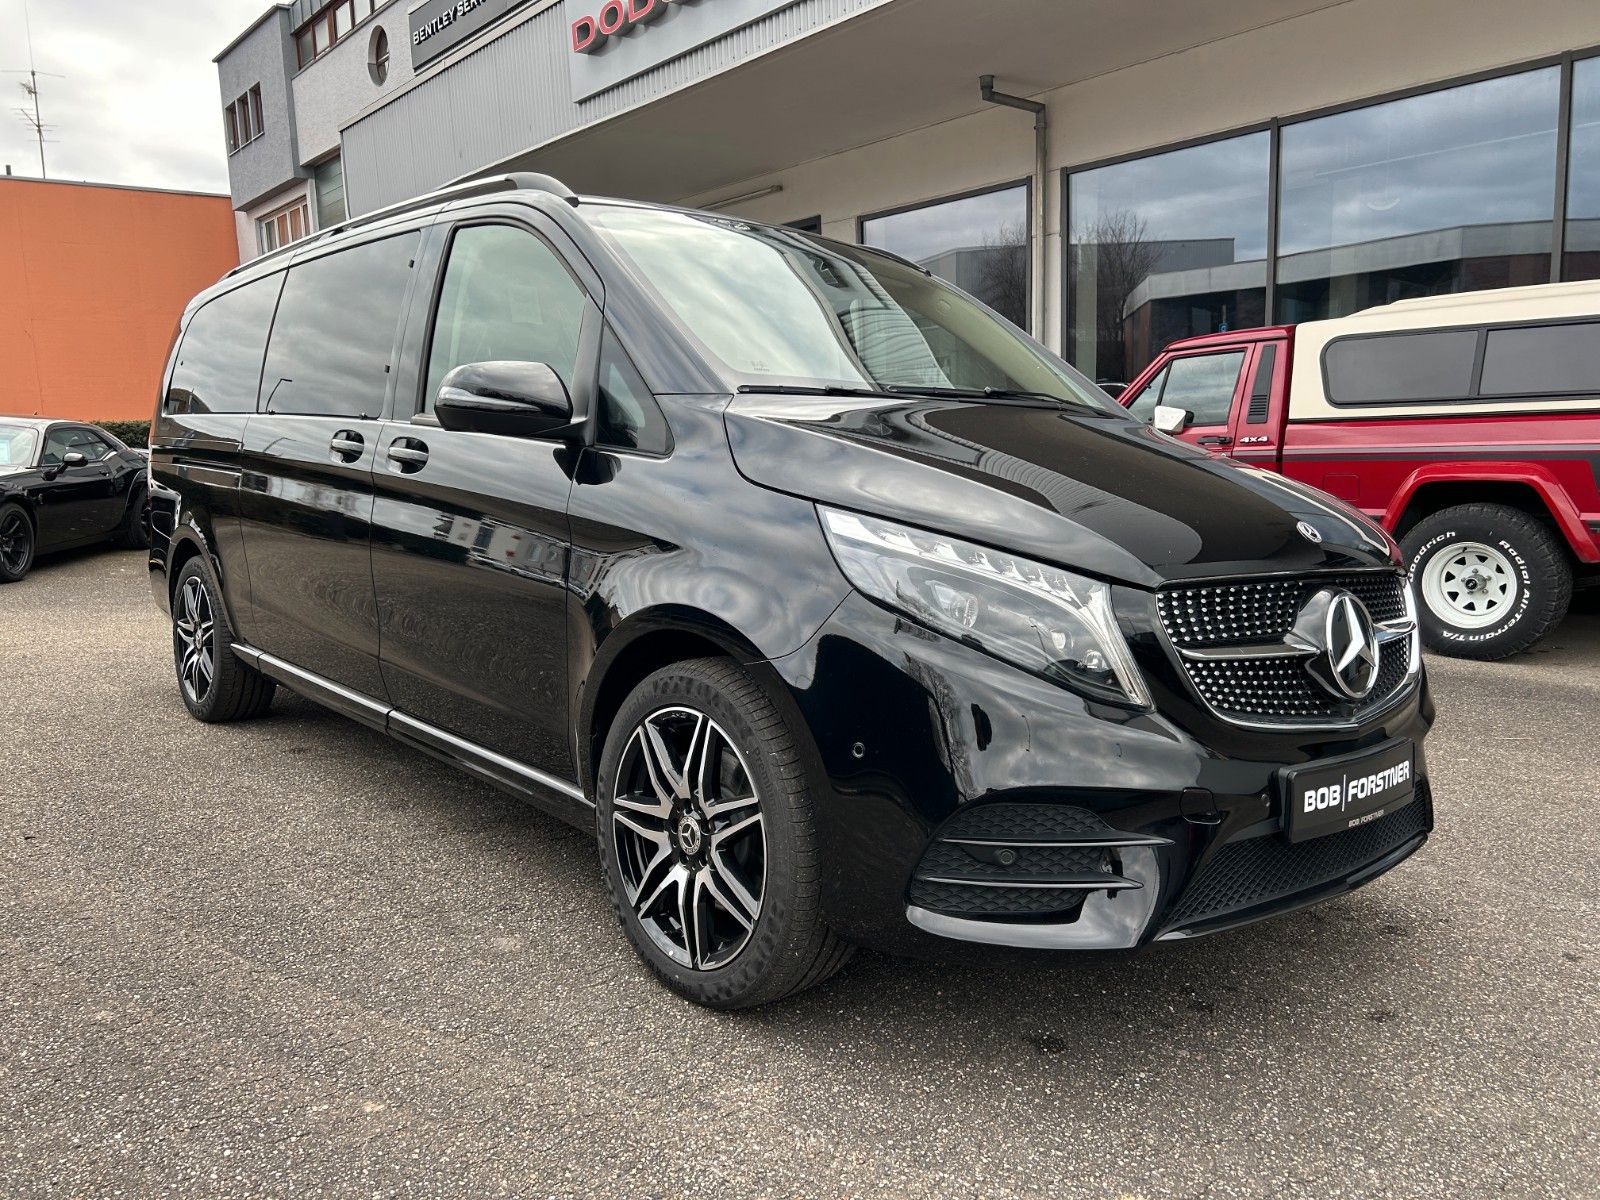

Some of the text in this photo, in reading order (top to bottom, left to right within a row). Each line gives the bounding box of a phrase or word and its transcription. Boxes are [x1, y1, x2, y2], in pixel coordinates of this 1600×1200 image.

[412, 0, 481, 45] BENTLEY SER
[571, 0, 673, 53] DOD
[1498, 540, 1531, 585] Radial
[1442, 630, 1466, 641] T/A
[1468, 588, 1531, 641] All-Terrain
[1303, 760, 1410, 813] BOB FORSTNER
